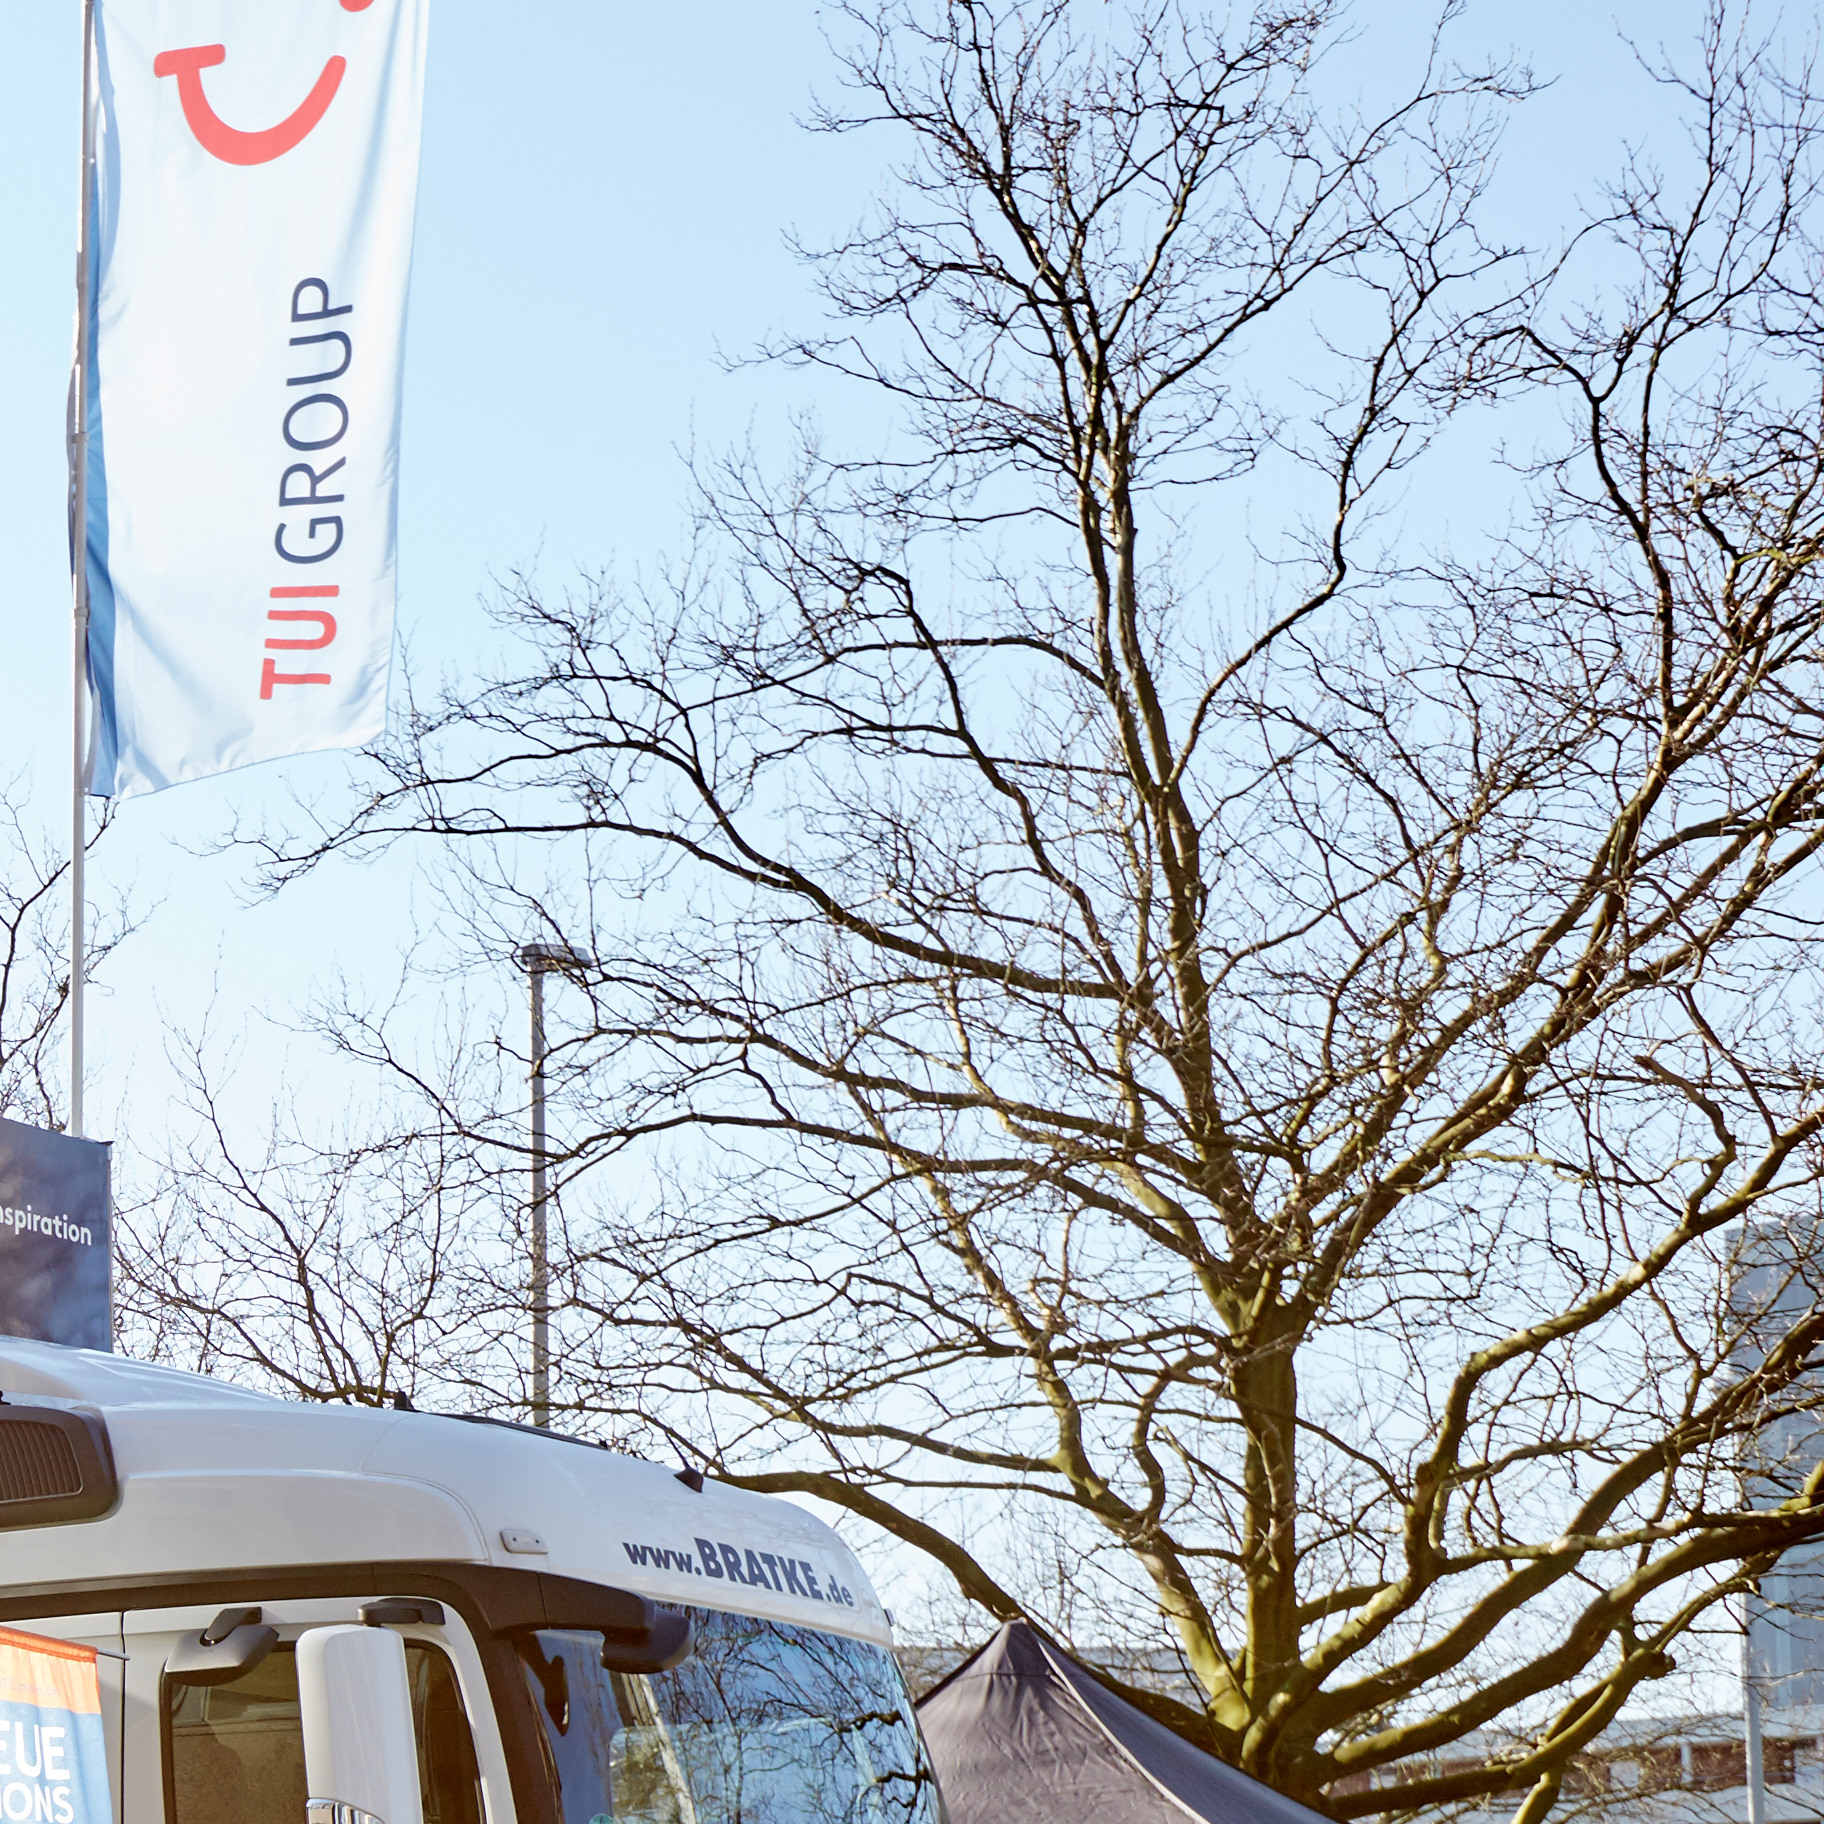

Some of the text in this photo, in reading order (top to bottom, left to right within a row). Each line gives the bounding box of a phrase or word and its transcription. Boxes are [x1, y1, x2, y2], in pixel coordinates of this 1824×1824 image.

[259, 277, 353, 700] TUI GROUP
[622, 1537, 854, 1607] www.BRATKE.de
